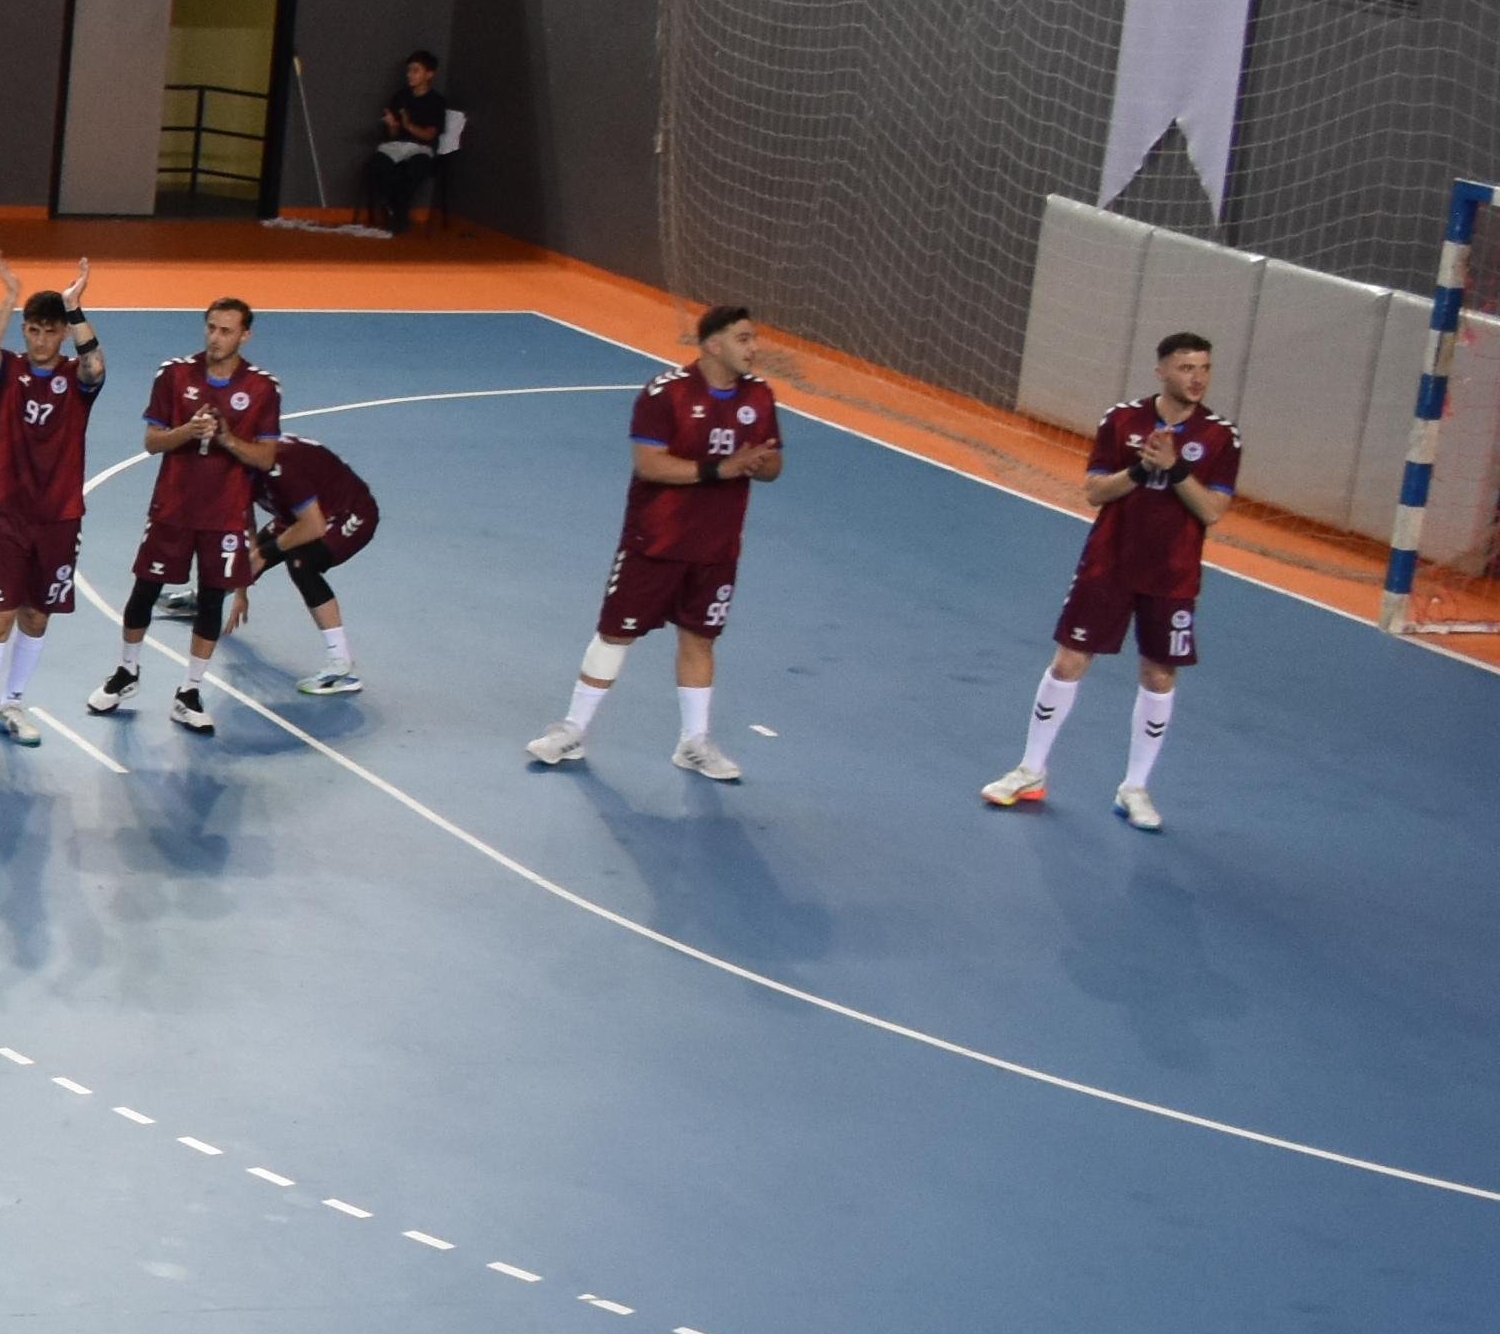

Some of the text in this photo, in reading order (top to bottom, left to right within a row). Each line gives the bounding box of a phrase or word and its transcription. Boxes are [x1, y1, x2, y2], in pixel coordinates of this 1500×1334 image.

[23, 399, 54, 426] 97
[707, 427, 736, 456] 99
[221, 552, 236, 578] 7
[44, 579, 73, 605] 97
